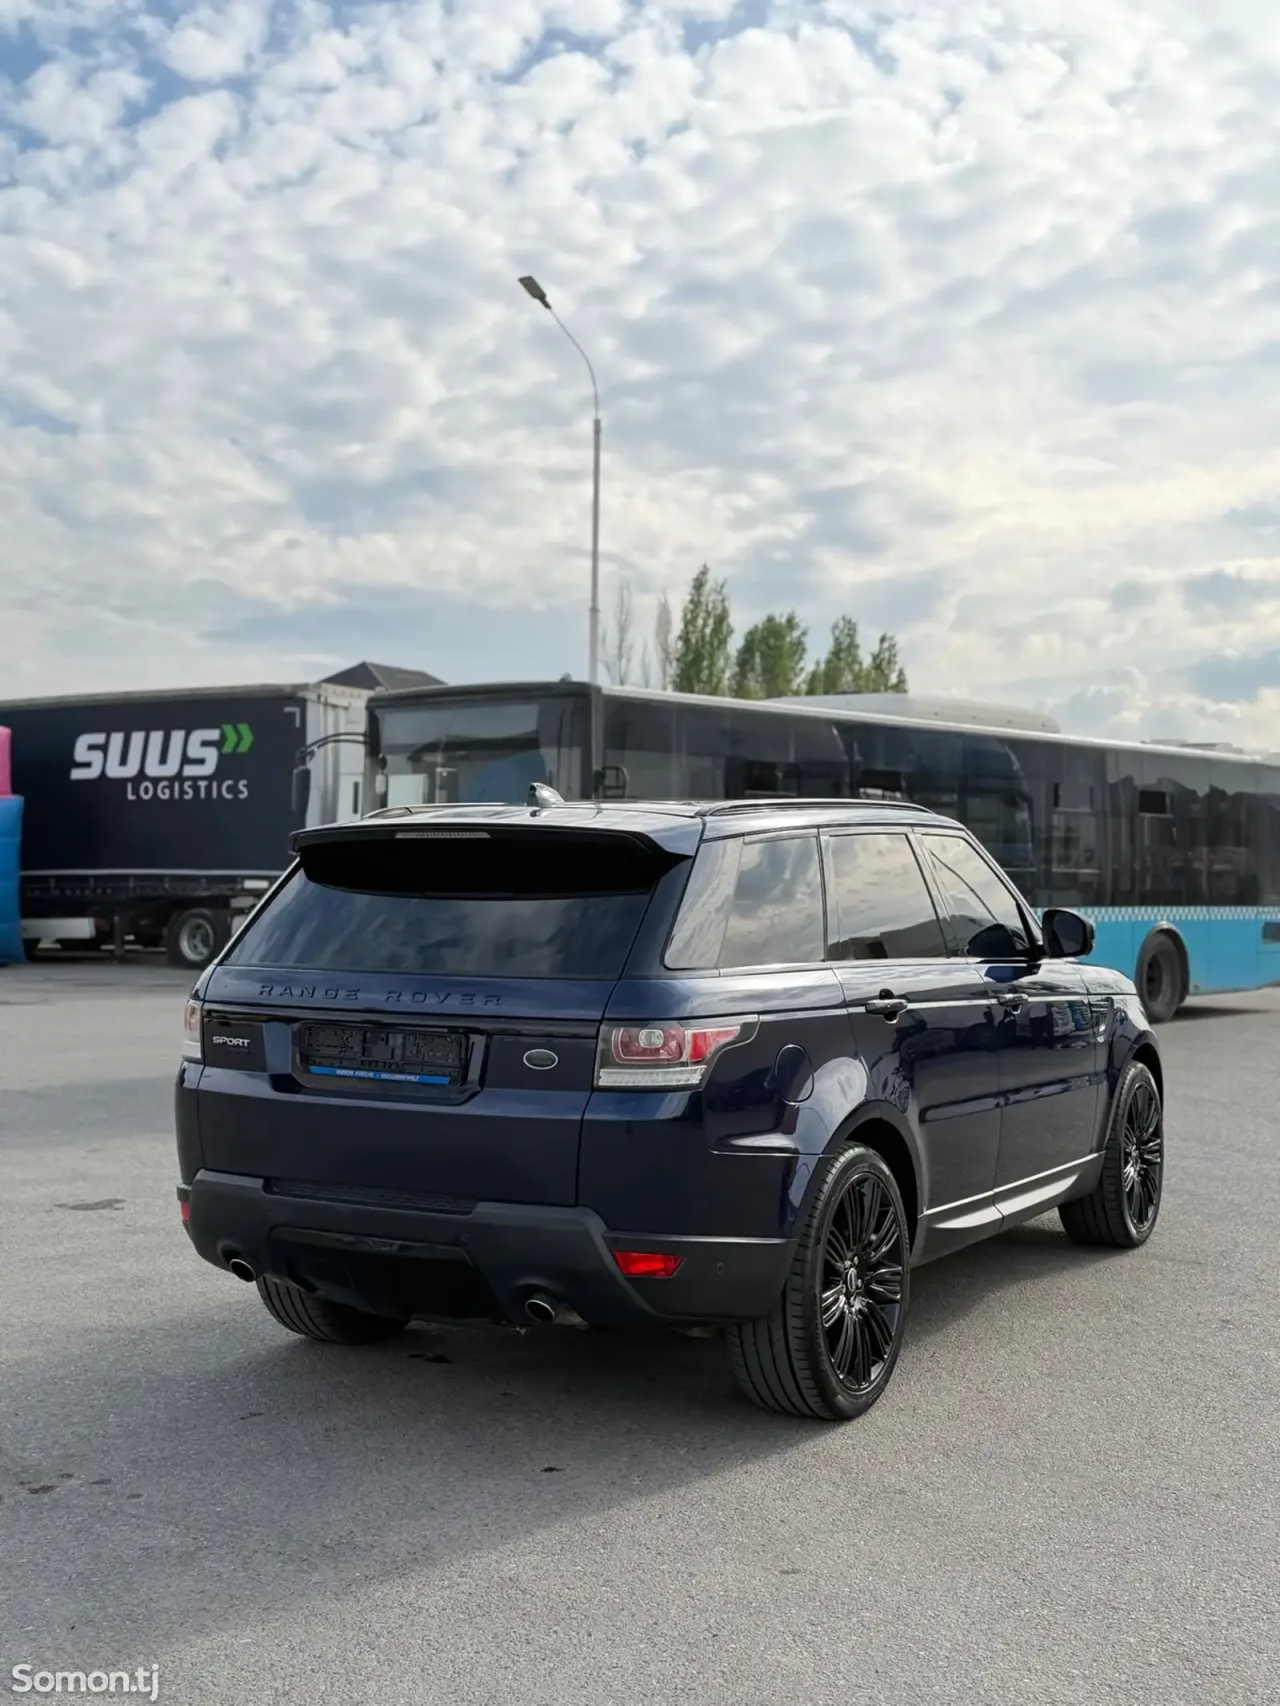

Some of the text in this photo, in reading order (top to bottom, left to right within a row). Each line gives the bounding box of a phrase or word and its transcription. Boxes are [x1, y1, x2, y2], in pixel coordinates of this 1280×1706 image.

[70, 728, 221, 780] SUUS
[127, 780, 249, 800] LOGISTICS
[259, 985, 502, 1006] RANGE ROVER
[212, 1035, 251, 1047] SPORT
